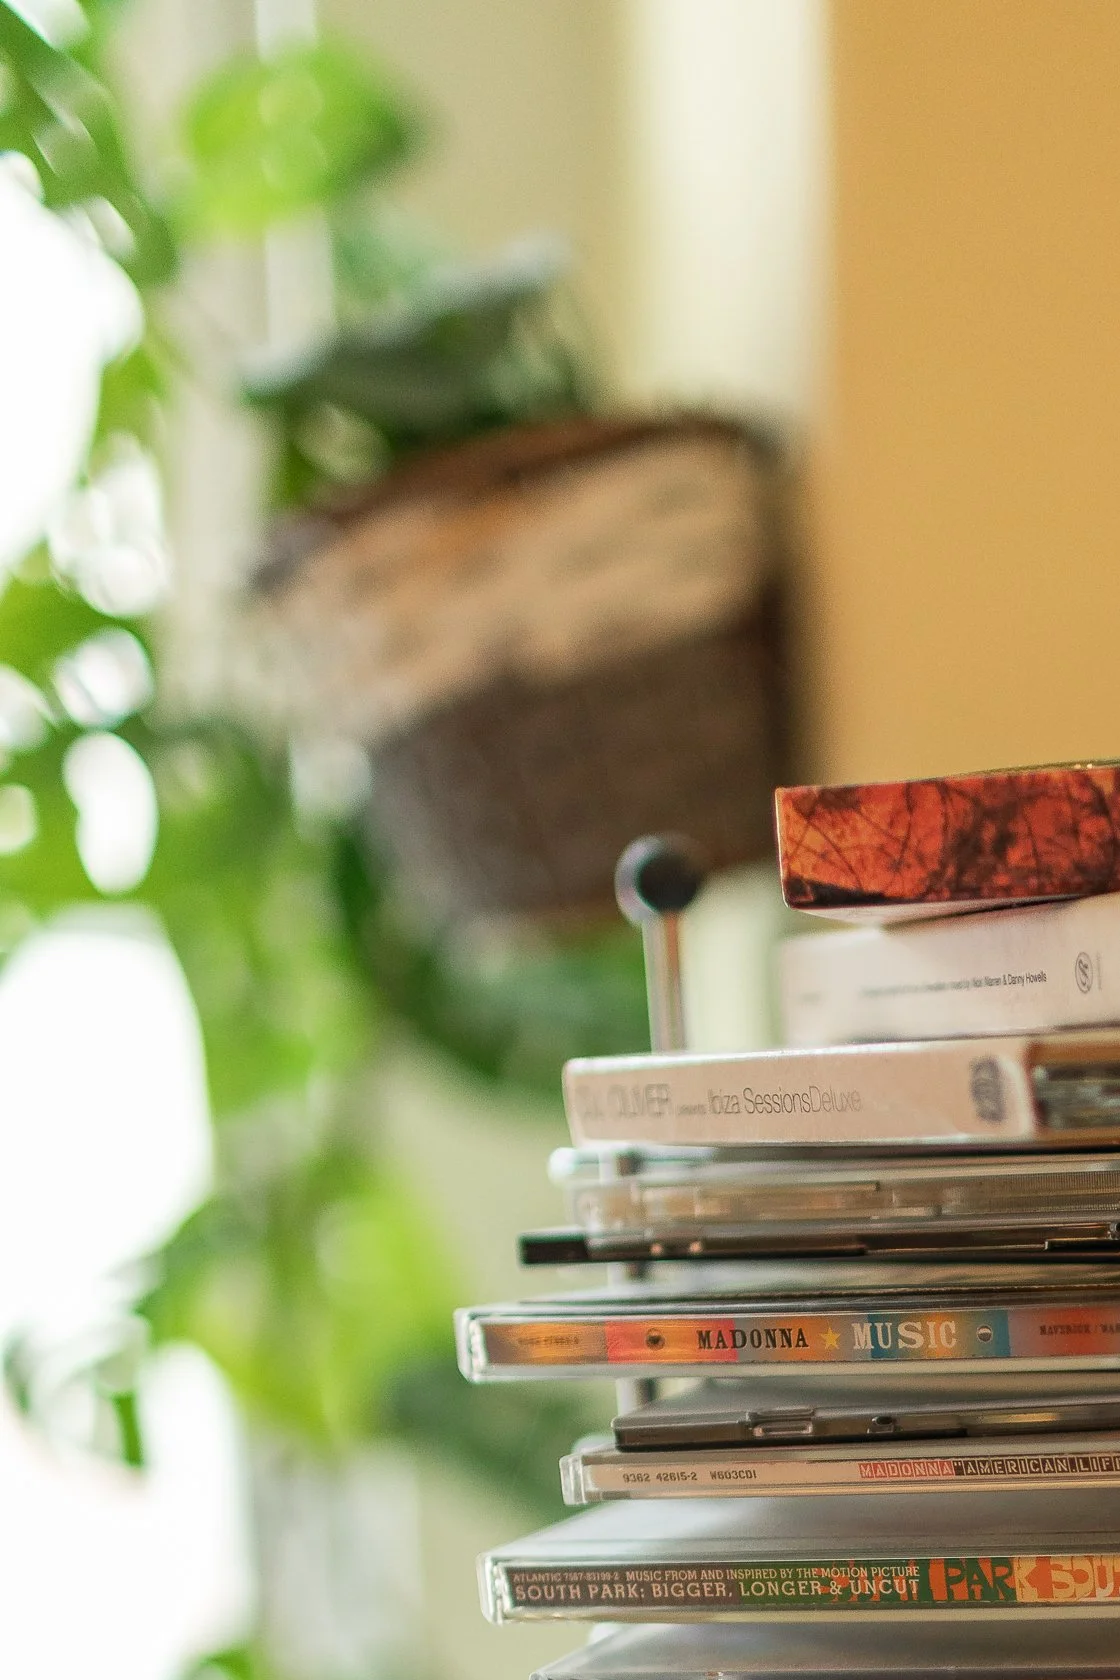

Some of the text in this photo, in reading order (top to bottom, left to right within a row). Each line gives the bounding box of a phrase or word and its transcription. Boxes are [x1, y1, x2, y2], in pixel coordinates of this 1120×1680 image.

[1007, 973, 1024, 986] Danny
[1025, 970, 1047, 984] Howells
[708, 1088, 740, 1115] Ibiza
[696, 1320, 958, 1350] MADONNA MUSIC
[622, 1473, 650, 1483] 9362
[655, 1471, 697, 1482] 42615-2
[858, 1459, 954, 1479] MADONNA
[625, 1570, 661, 1581] MUSIC
[664, 1569, 697, 1581] FROM
[700, 1569, 723, 1580] AND
[726, 1568, 777, 1580] INSPIRED
[780, 1568, 793, 1578] BY
[796, 1567, 817, 1578] THE
[819, 1566, 868, 1577] MOTION
[871, 1566, 920, 1577] PICTURE
[515, 1584, 581, 1600] SOUTH
[588, 1582, 645, 1599] PARK:
[738, 1580, 823, 1597] LONGER
[830, 1581, 842, 1595] &
[850, 1579, 920, 1596] UNCUT
